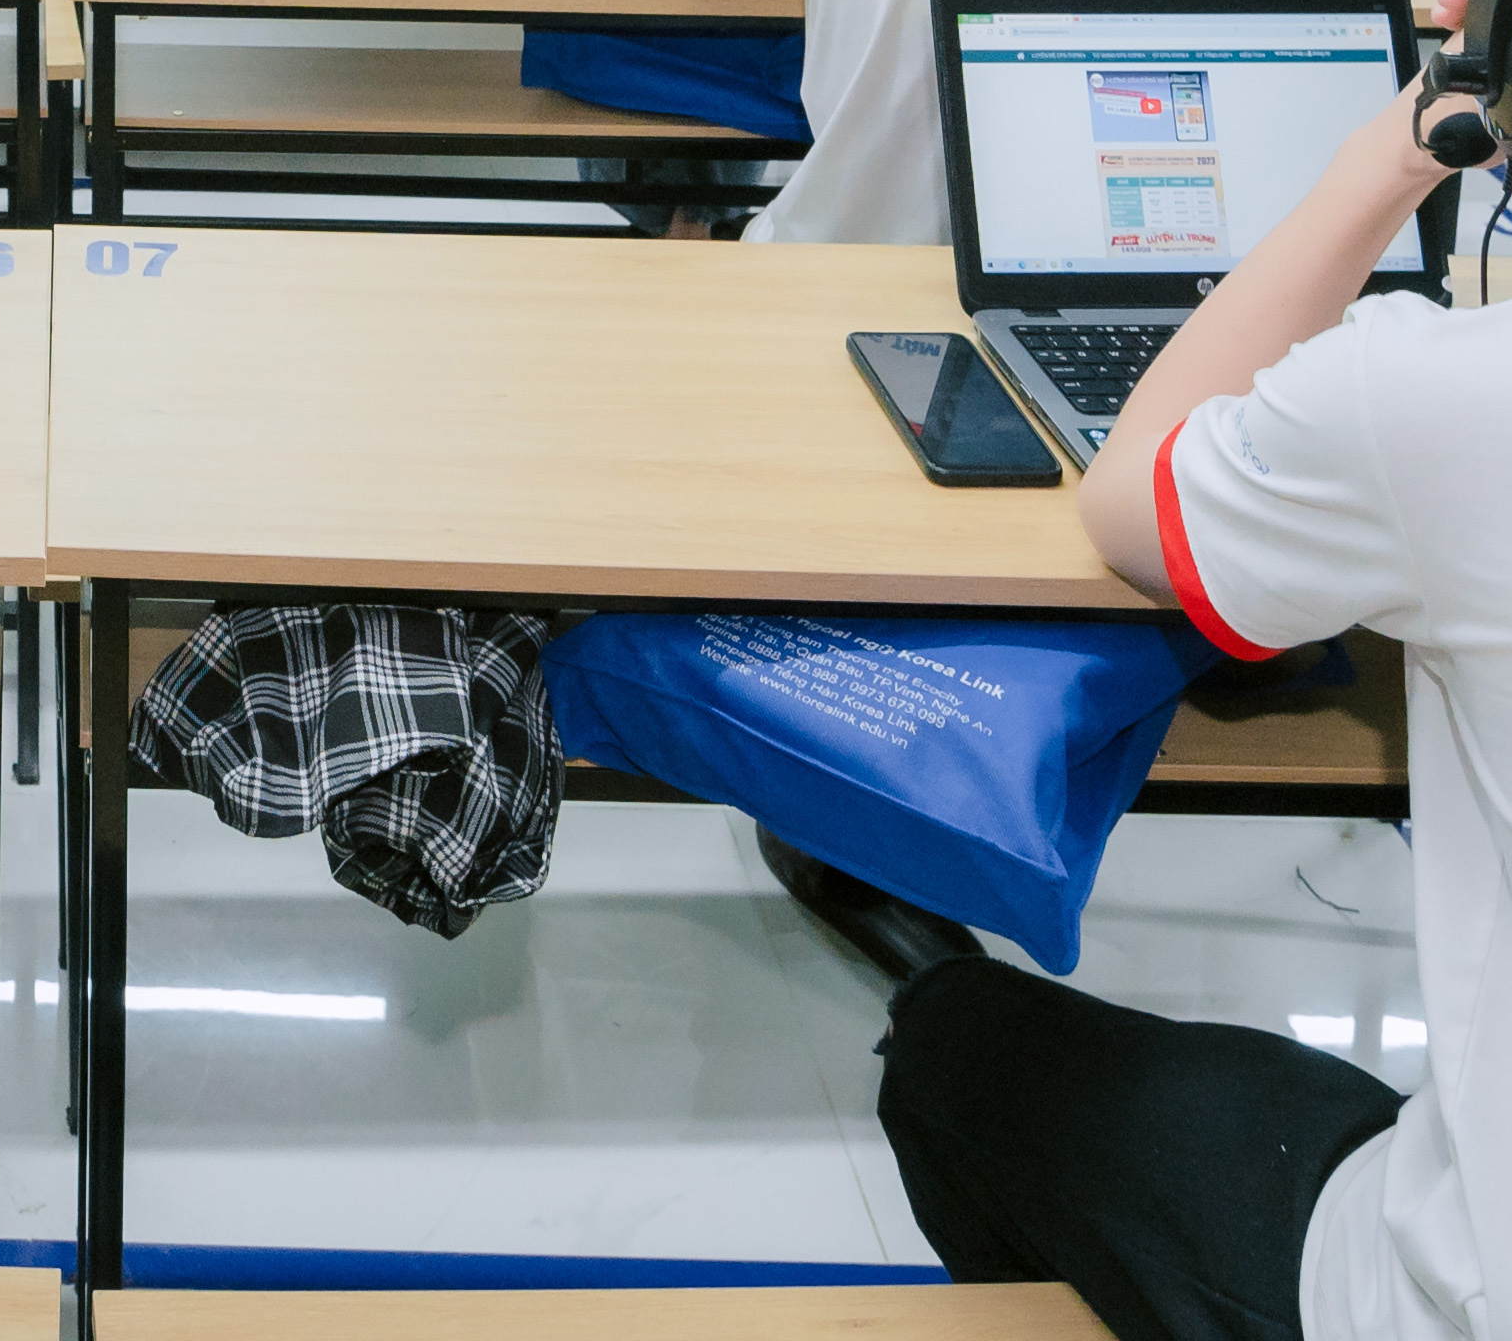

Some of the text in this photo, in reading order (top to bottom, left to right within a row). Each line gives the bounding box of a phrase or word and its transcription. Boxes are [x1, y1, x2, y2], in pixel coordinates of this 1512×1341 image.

[1196, 156, 1216, 166] 2023
[86, 240, 178, 278] 07
[897, 649, 957, 678] Korea
[959, 670, 1006, 701] Link
[911, 677, 964, 708] Ecocity
[759, 673, 910, 750] www.korealink.edu.vn
[842, 694, 886, 721] Korea
[887, 712, 918, 737] Link
[971, 721, 994, 738] An
